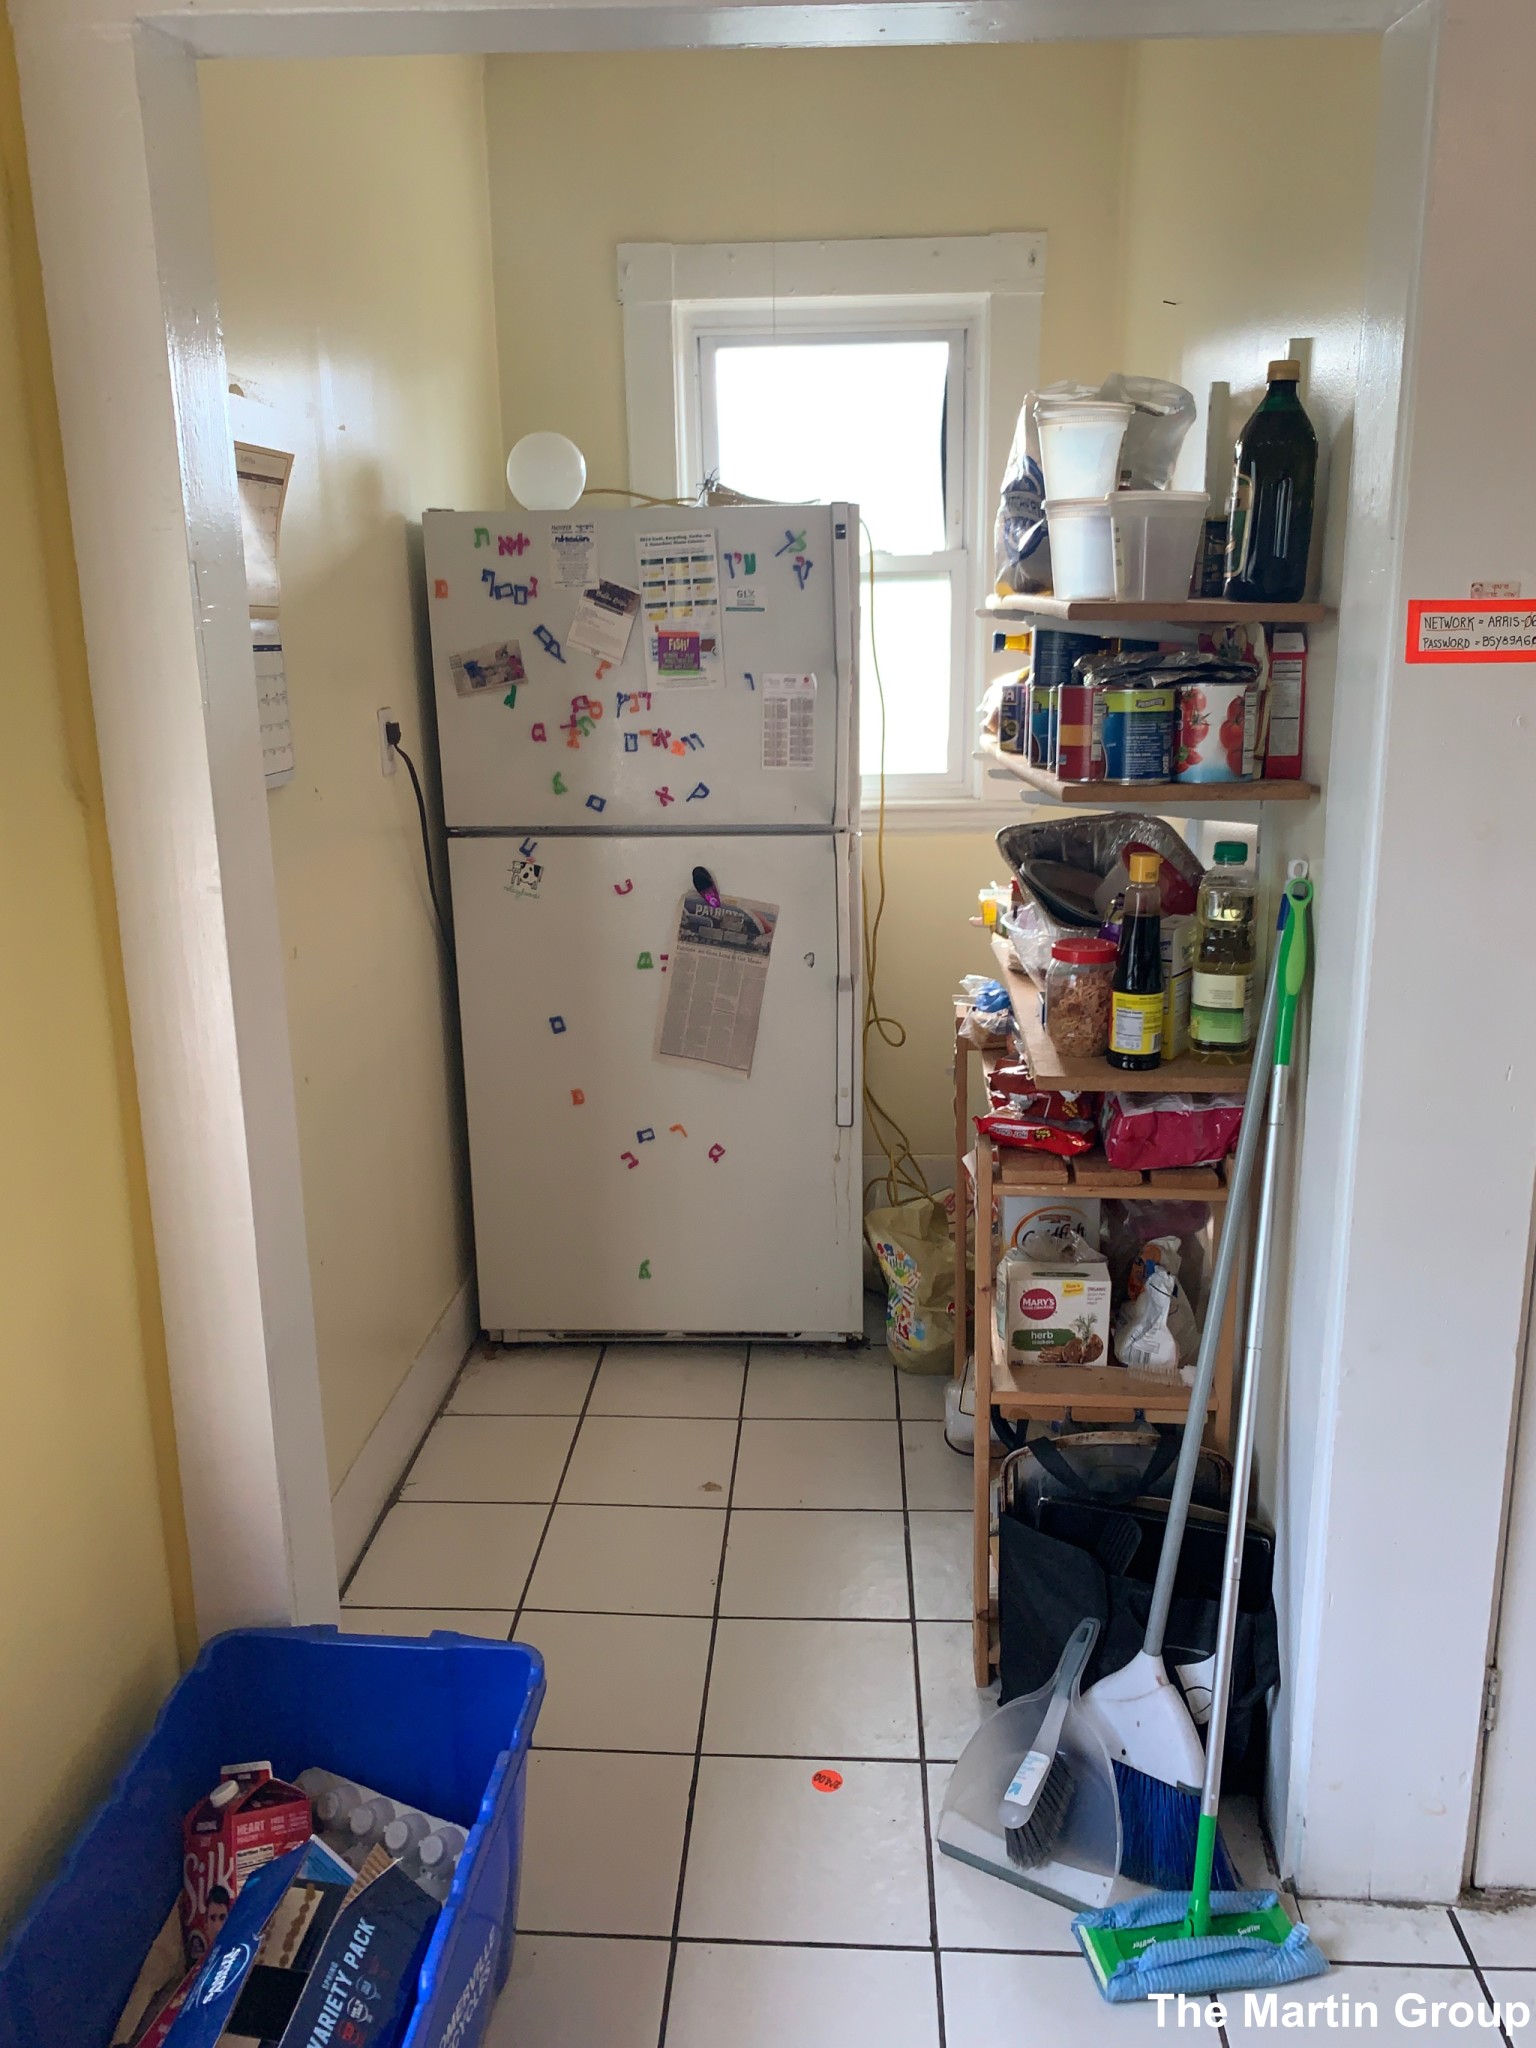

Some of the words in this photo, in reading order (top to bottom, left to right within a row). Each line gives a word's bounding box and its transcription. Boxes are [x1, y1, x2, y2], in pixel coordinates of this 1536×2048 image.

[1423, 616, 1475, 632] NETWORK
[668, 638, 690, 651] FISH!
[1422, 637, 1471, 651] PASSWORD
[1022, 1297, 1055, 1307] MARY'S
[1030, 1331, 1054, 1340] herb
[236, 1820, 266, 1836] HEART
[183, 1841, 236, 1926] Silk
[343, 1917, 376, 1970] PACK
